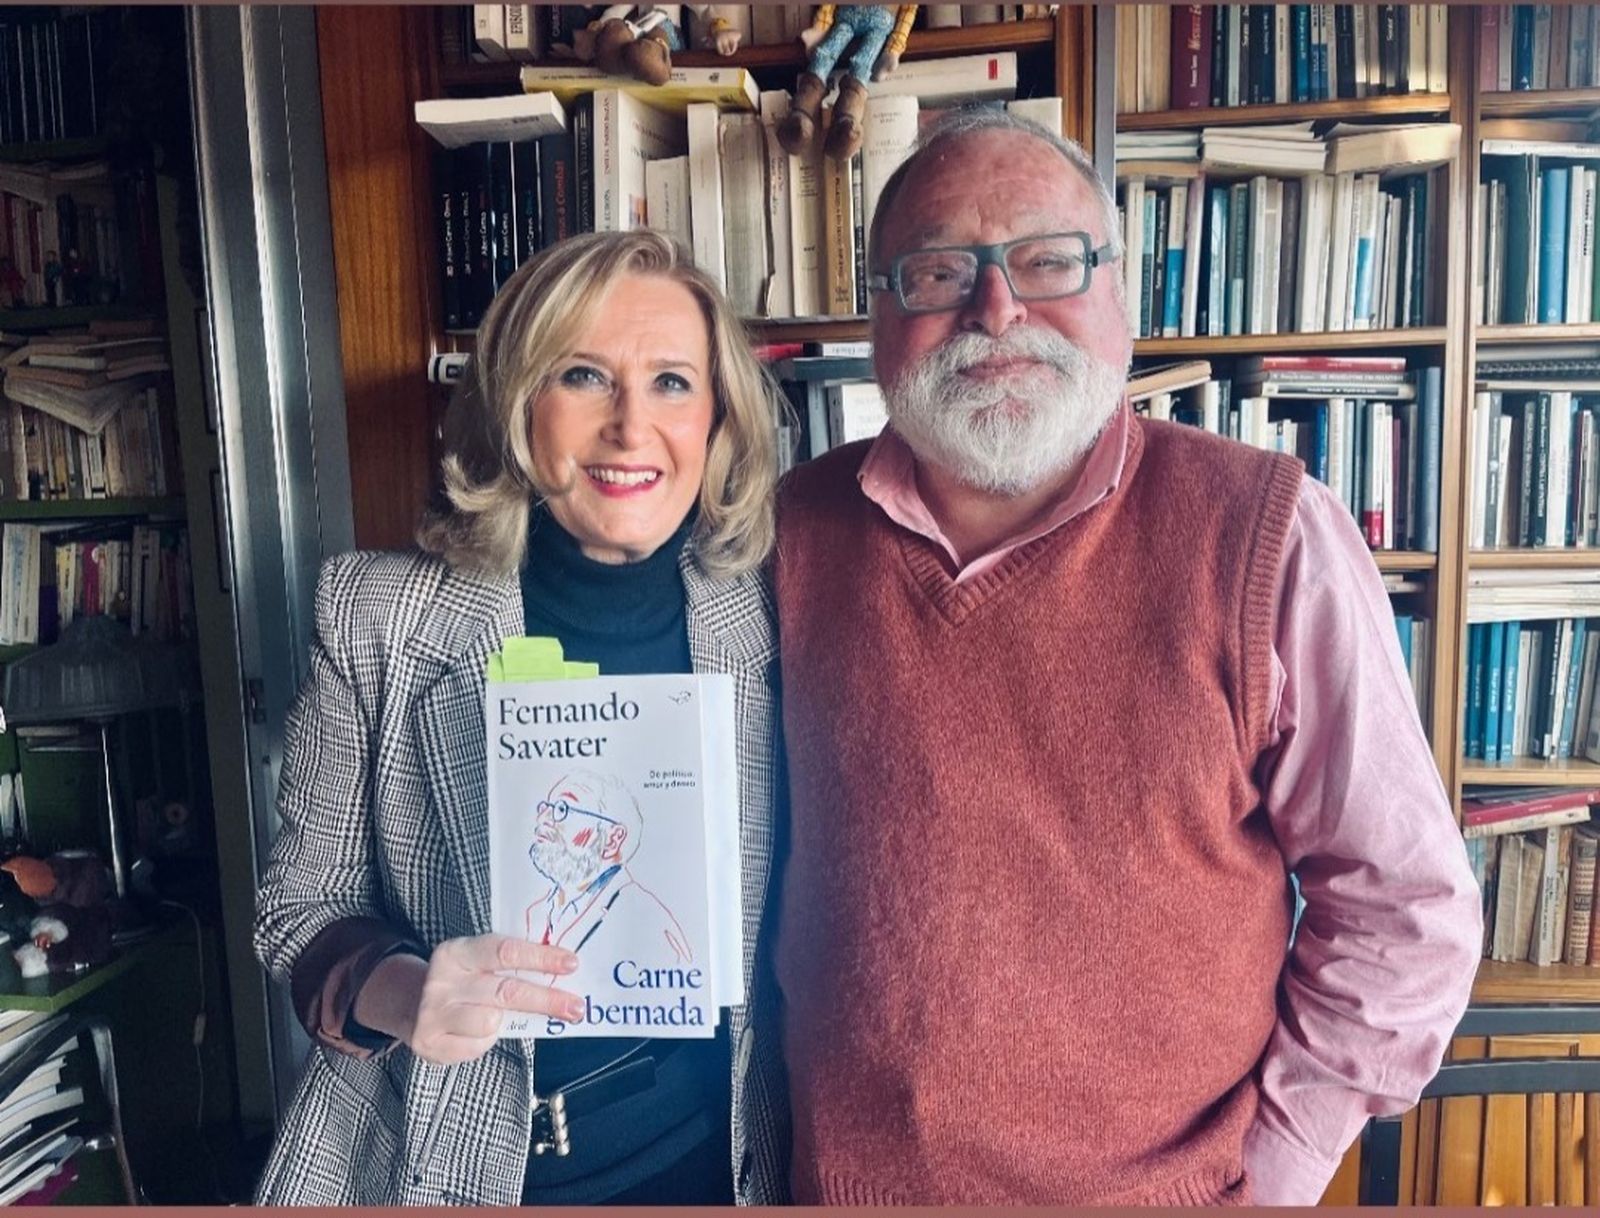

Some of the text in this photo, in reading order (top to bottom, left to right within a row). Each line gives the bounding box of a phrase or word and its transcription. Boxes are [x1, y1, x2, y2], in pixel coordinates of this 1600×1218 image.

[499, 691, 640, 726] Fernando
[498, 732, 607, 761] Savater
[649, 770, 661, 779] De
[613, 960, 702, 989] Carne
[546, 995, 704, 1036] gbernada
